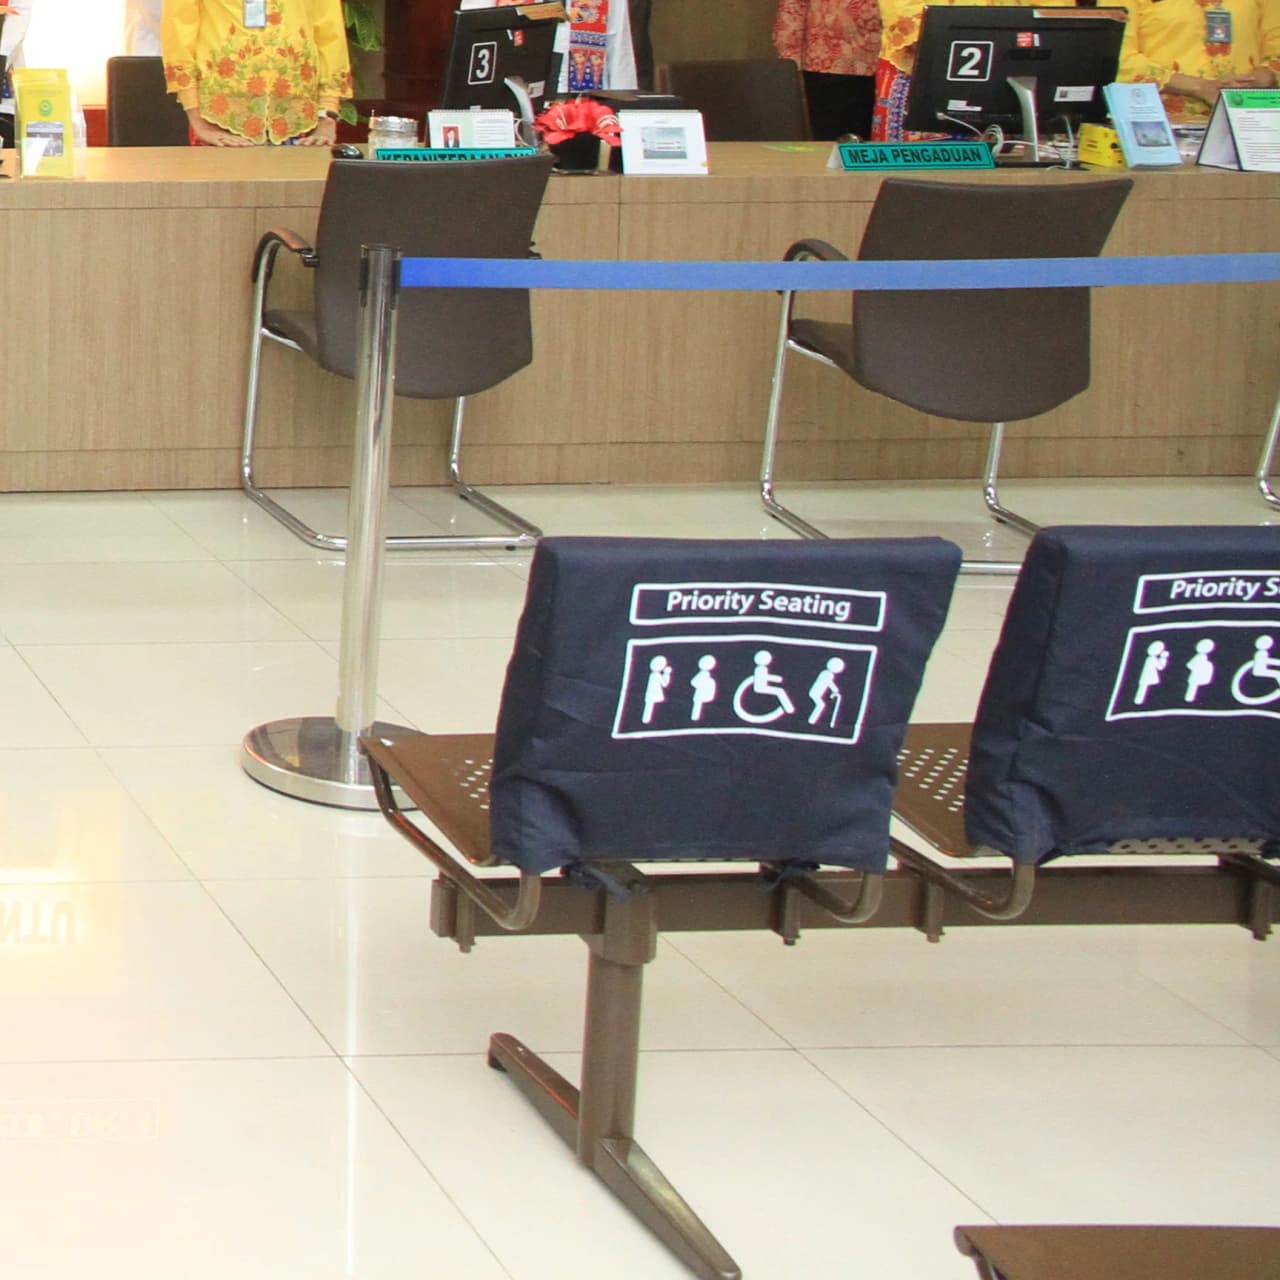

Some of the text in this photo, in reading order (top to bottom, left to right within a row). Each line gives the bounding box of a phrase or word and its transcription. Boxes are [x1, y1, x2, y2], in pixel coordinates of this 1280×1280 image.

[475, 48, 490, 79] 3
[957, 47, 982, 76] 2
[847, 147, 982, 164] MEJA PENGADUAN
[1169, 577, 1280, 601] Priority S
[666, 590, 852, 622] Priority Seating
